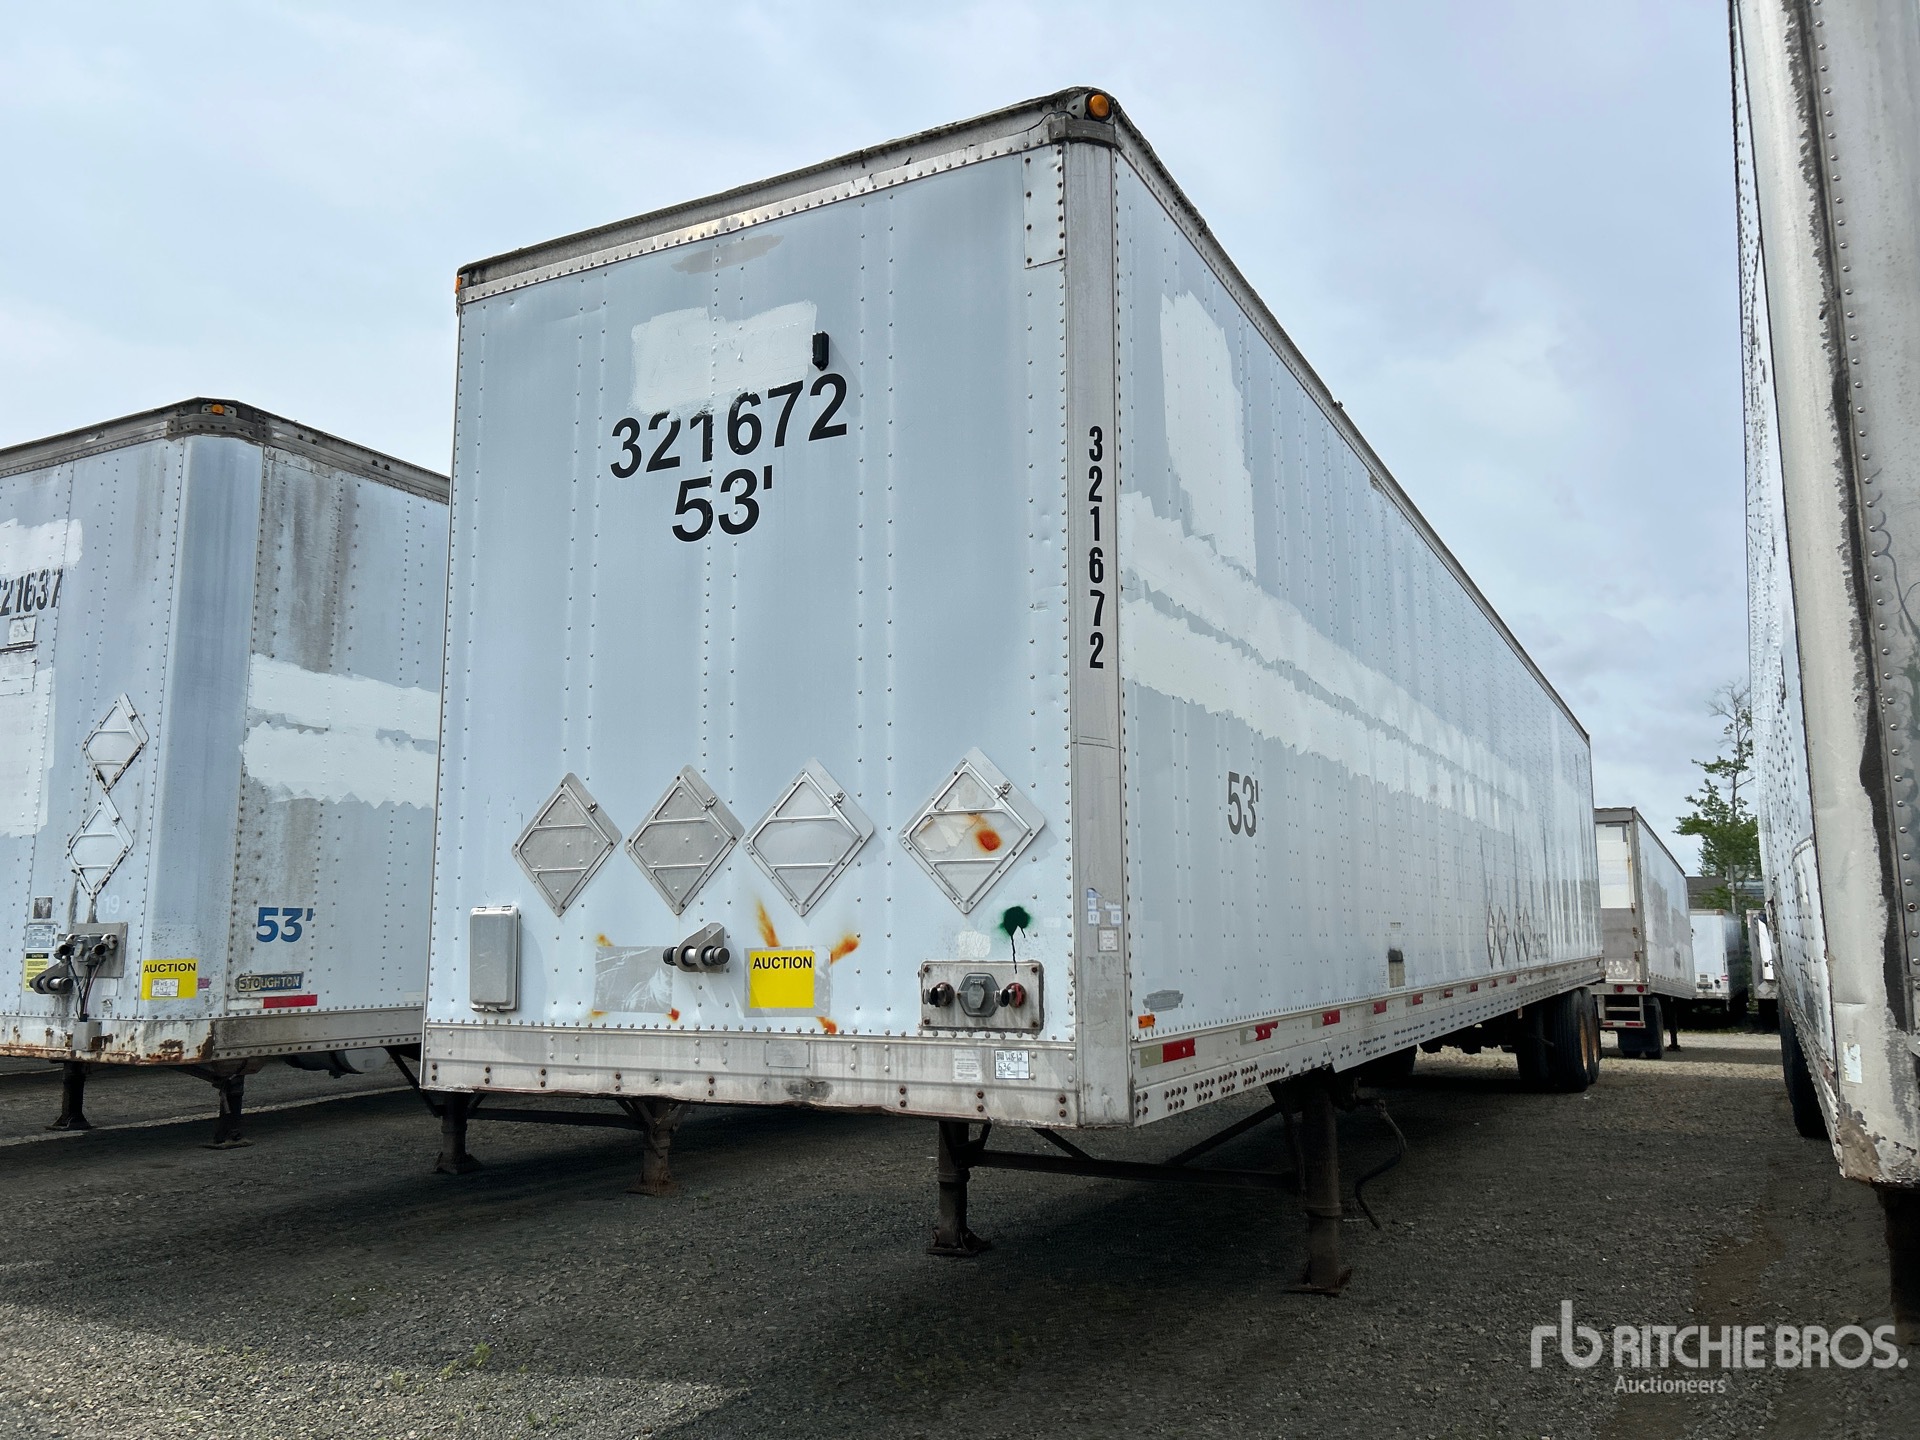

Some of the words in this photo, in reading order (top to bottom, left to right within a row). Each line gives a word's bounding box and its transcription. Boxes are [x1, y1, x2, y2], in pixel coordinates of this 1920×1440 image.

[610, 373, 847, 479] 321672
[671, 464, 773, 542] 53'
[1088, 425, 1105, 669] 321672
[0, 568, 63, 617] 21637
[1227, 771, 1259, 837] 53'
[256, 907, 314, 943] 53'
[143, 963, 196, 973] AUCTION
[239, 976, 300, 989] STOUGHTON
[753, 956, 812, 969] AUCTION
